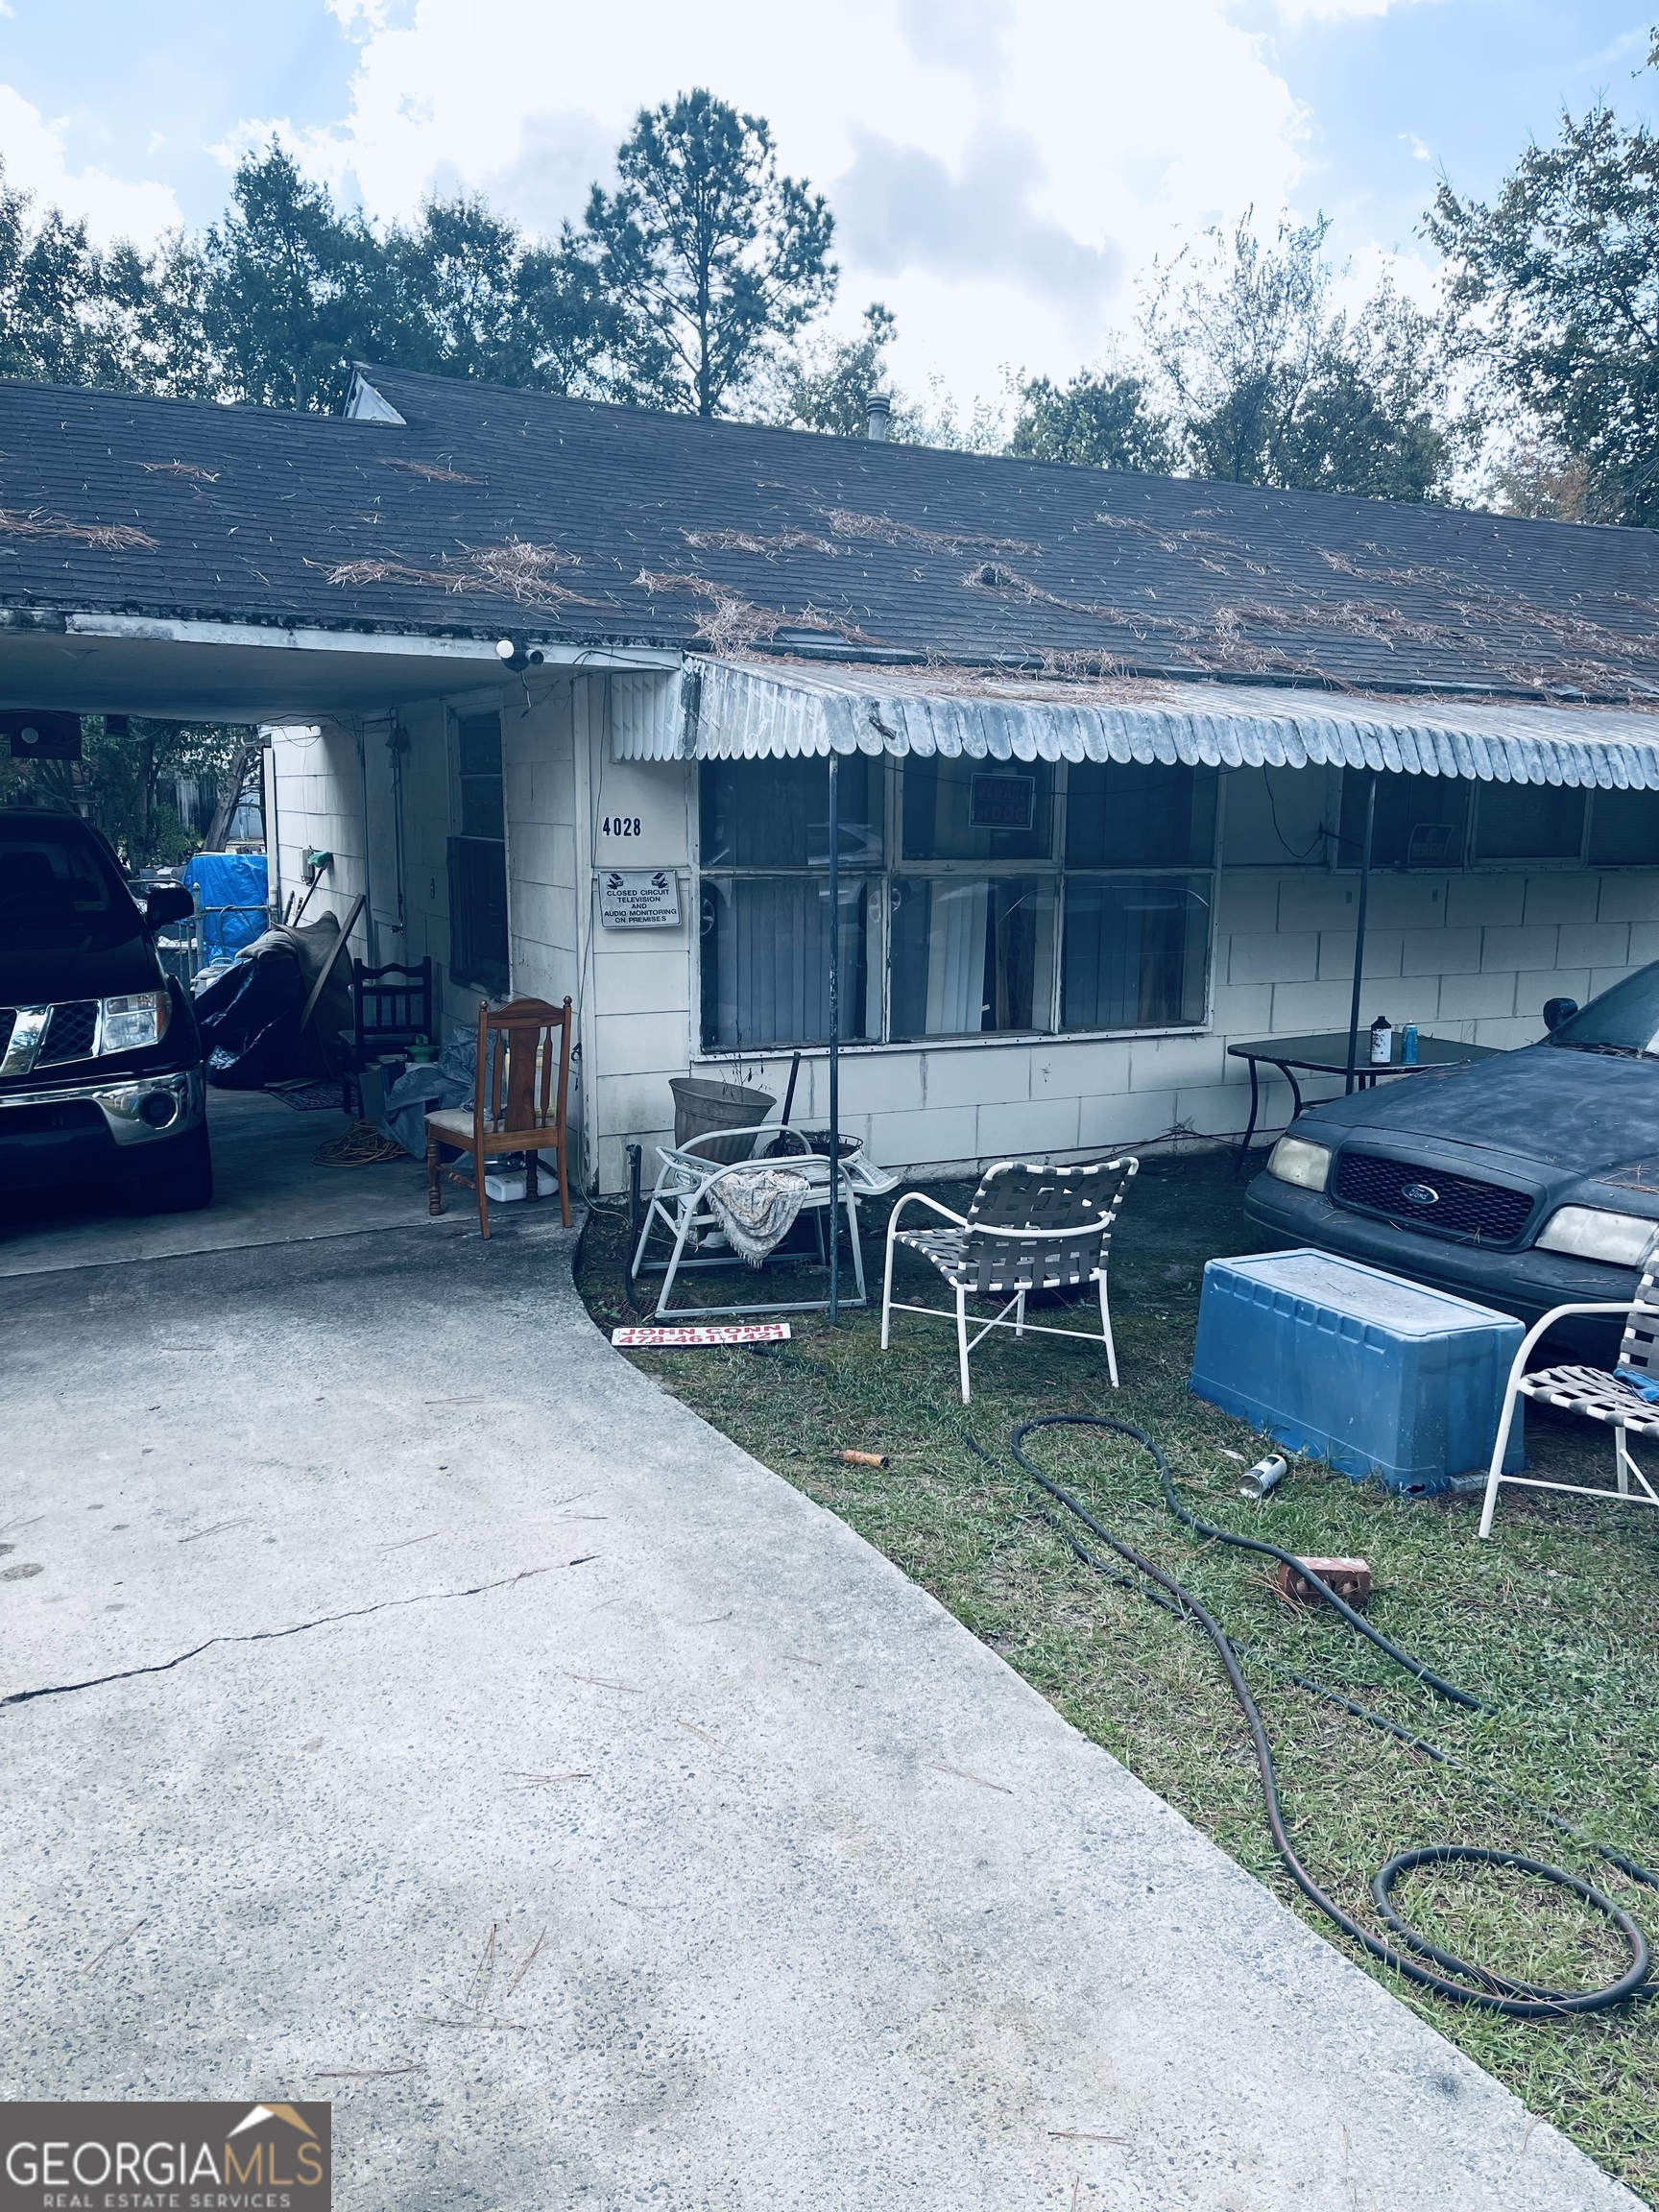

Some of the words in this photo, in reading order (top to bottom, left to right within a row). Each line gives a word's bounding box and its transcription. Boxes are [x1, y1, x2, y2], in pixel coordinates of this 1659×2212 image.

[992, 805, 1025, 822] DOG
[603, 817, 640, 836] 4028
[1409, 1188, 1430, 1199] Ford
[706, 1325, 781, 1334] CONN
[619, 1332, 783, 1344] 478-461-1421
